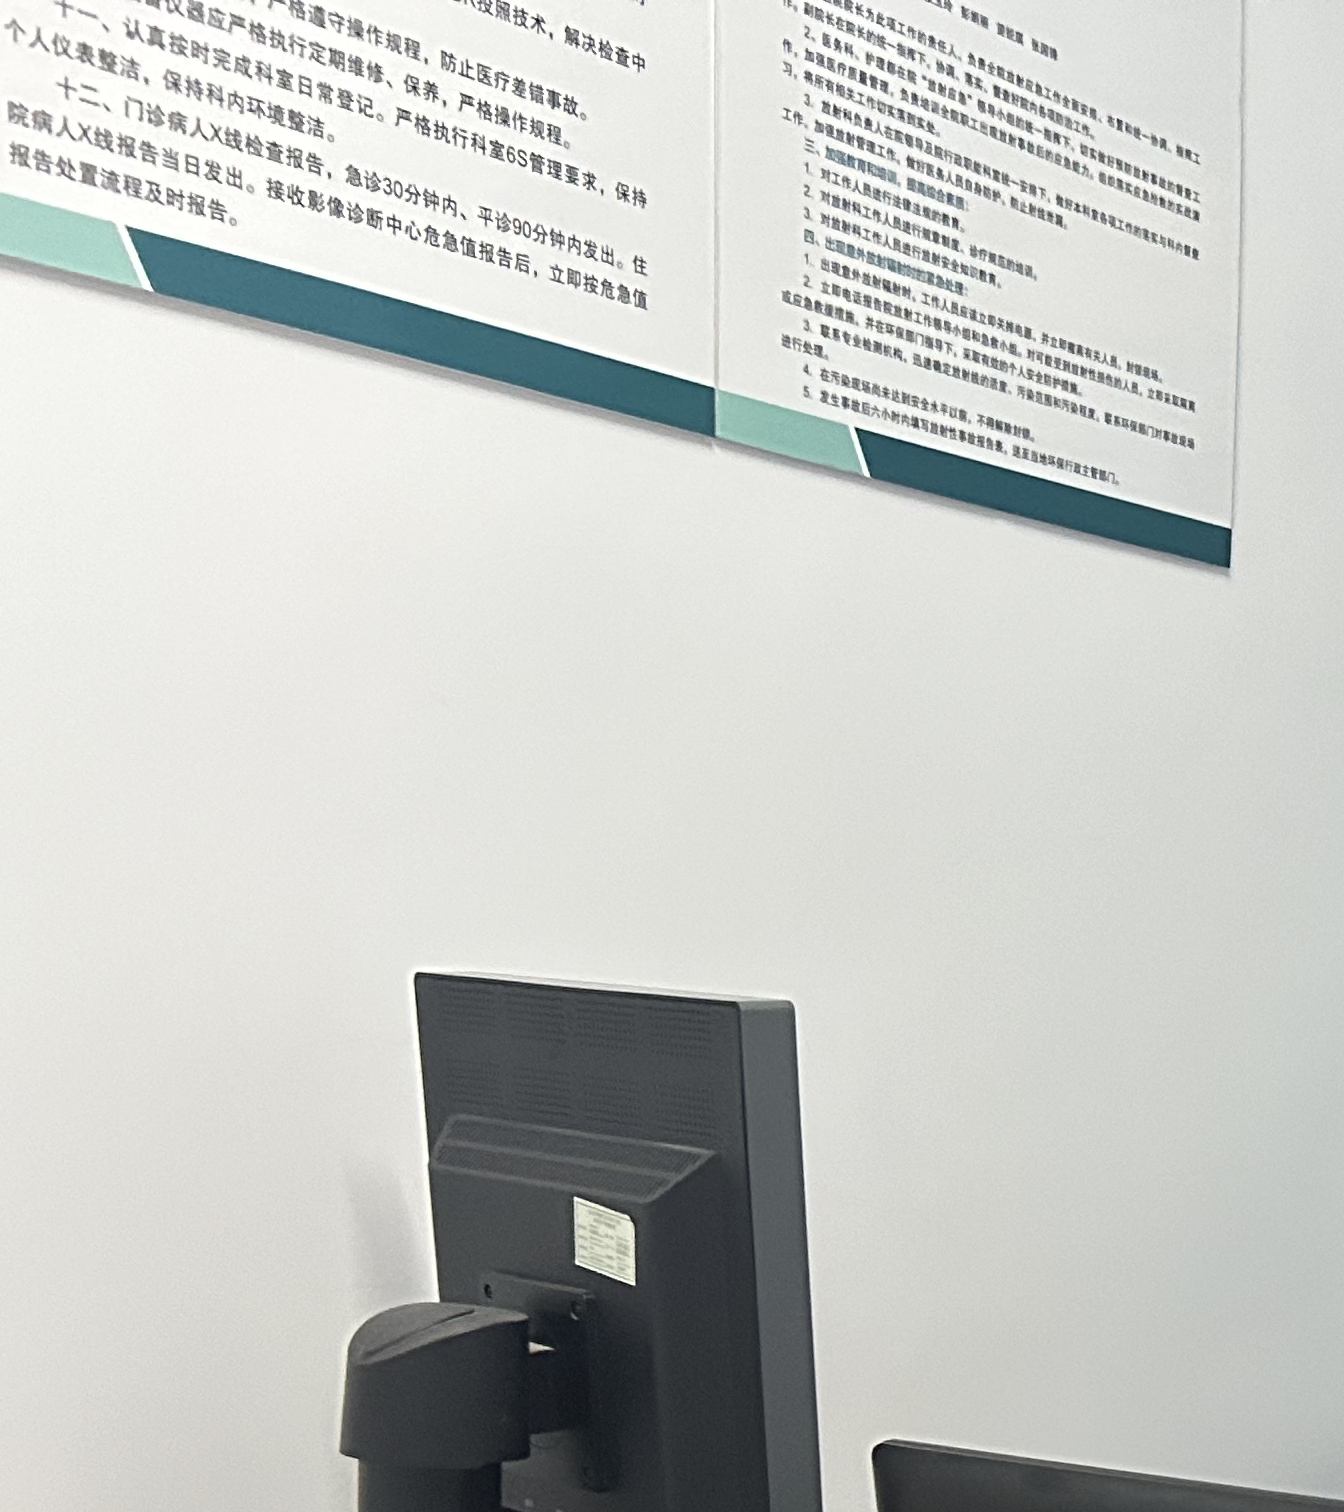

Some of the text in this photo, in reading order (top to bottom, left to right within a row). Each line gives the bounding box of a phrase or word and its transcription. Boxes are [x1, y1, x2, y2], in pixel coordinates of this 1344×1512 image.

[454, 0, 646, 72] 投照技术，解决检查中
[4, 18, 335, 143] 个人仪表整洁，保持科内环境整洁。
[9, 141, 238, 226] 报告处置流程及时报告。
